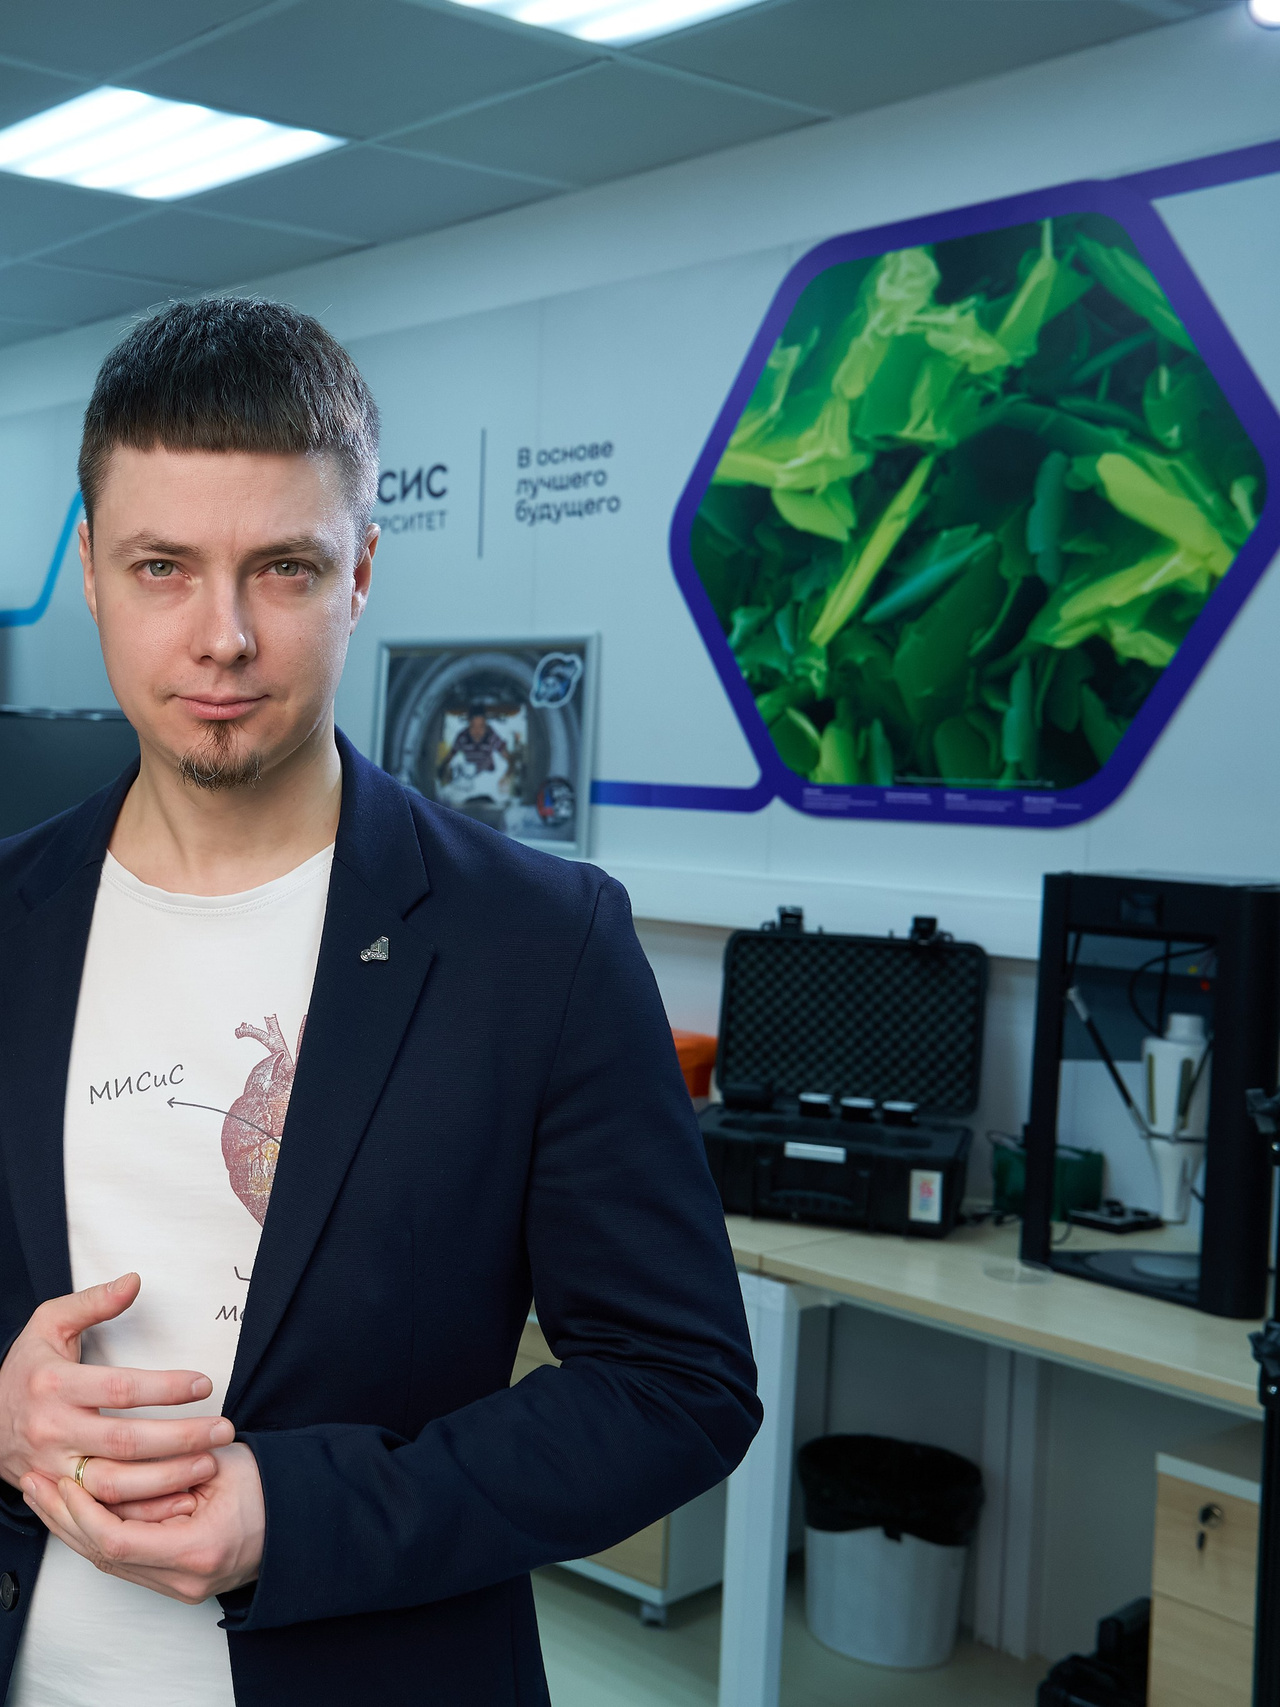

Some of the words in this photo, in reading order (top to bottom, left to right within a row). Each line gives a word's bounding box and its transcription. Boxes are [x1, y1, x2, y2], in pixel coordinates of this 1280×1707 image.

[517, 447, 531, 469] В
[536, 441, 614, 466] основе
[516, 469, 608, 501] лучшего
[372, 509, 448, 534] РСИТЕТ
[515, 496, 621, 527] будущего
